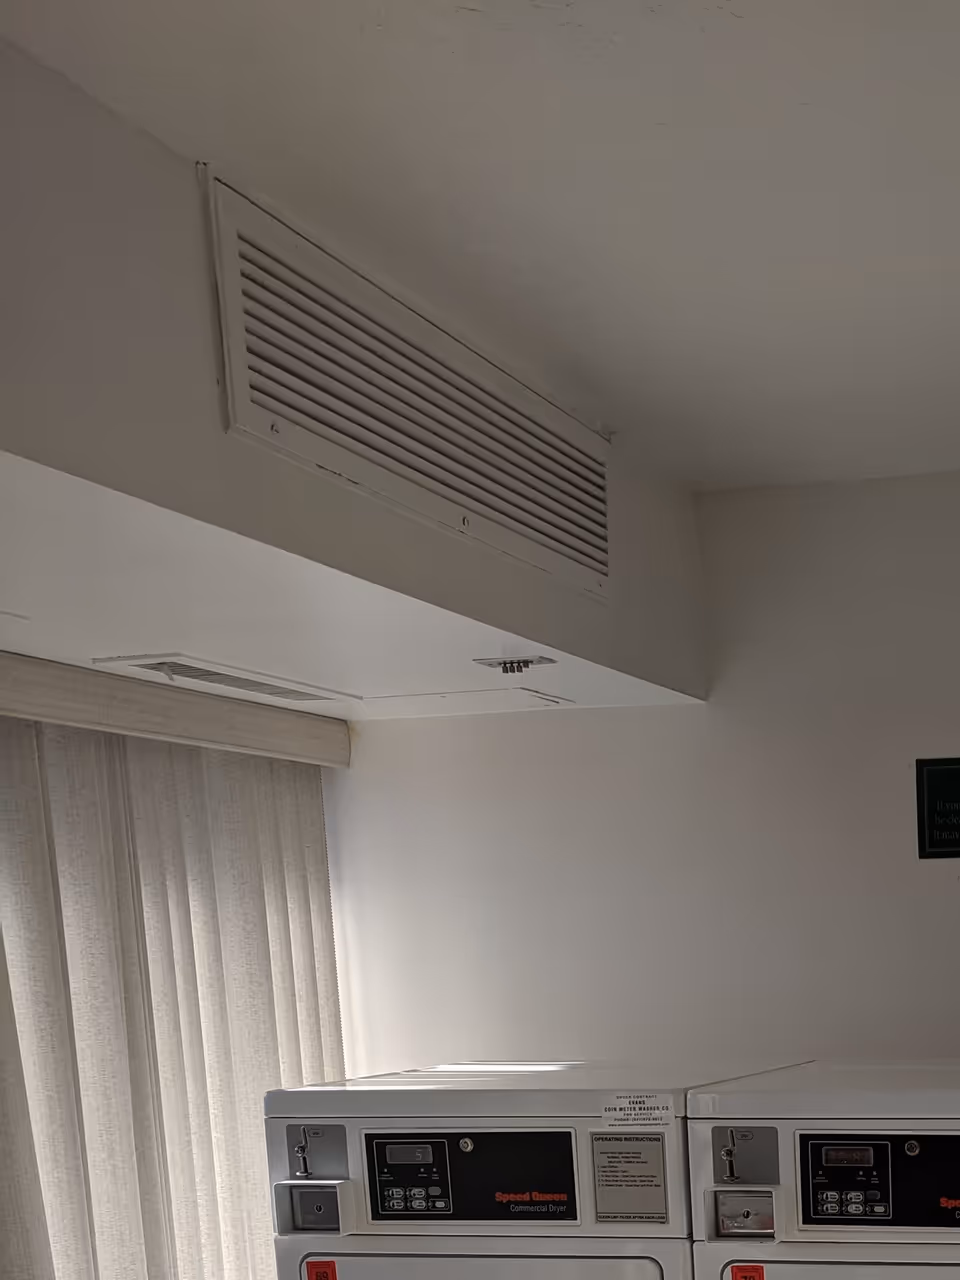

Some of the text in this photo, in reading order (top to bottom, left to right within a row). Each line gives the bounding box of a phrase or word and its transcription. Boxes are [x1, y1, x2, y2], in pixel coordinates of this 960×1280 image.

[495, 1191, 568, 1203] Speed Queen
[510, 1204, 567, 1214] Commercial Dryer
